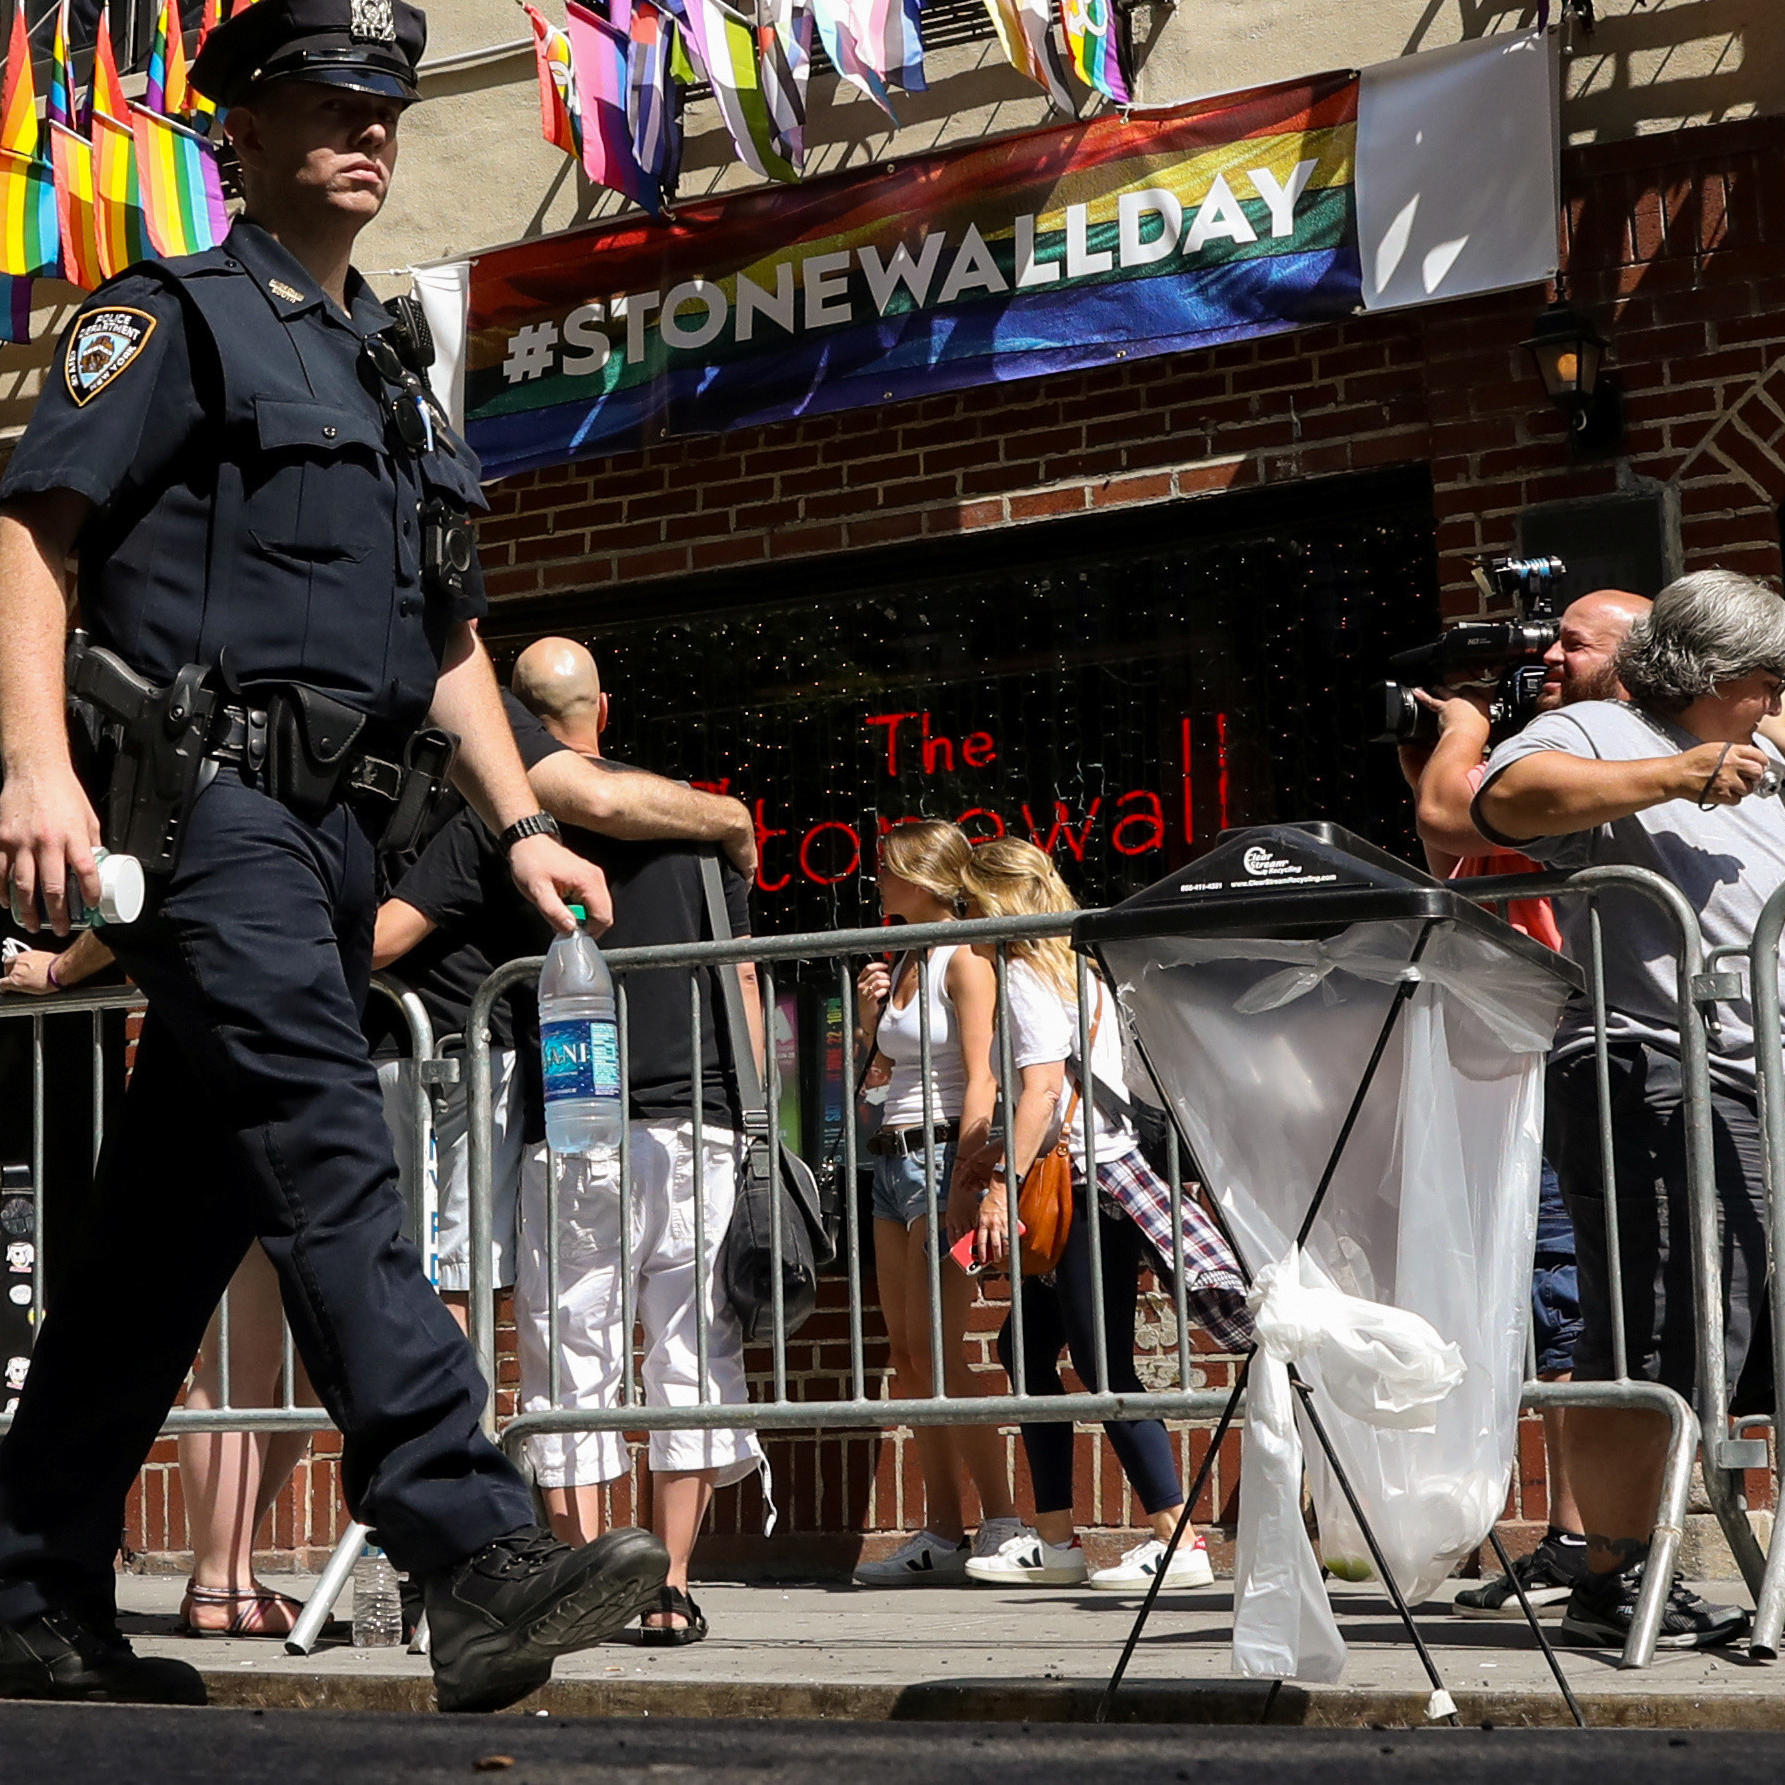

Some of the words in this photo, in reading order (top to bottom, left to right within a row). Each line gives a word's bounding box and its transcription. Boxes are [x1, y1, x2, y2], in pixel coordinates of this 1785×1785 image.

[501, 157, 1321, 382] #STONEWALLDAY
[95, 313, 133, 325] POLICE
[77, 322, 141, 341] DEPARTMENT
[109, 345, 137, 371] YORK
[865, 712, 997, 776] The
[1616, 1605, 1634, 1614] FIL
